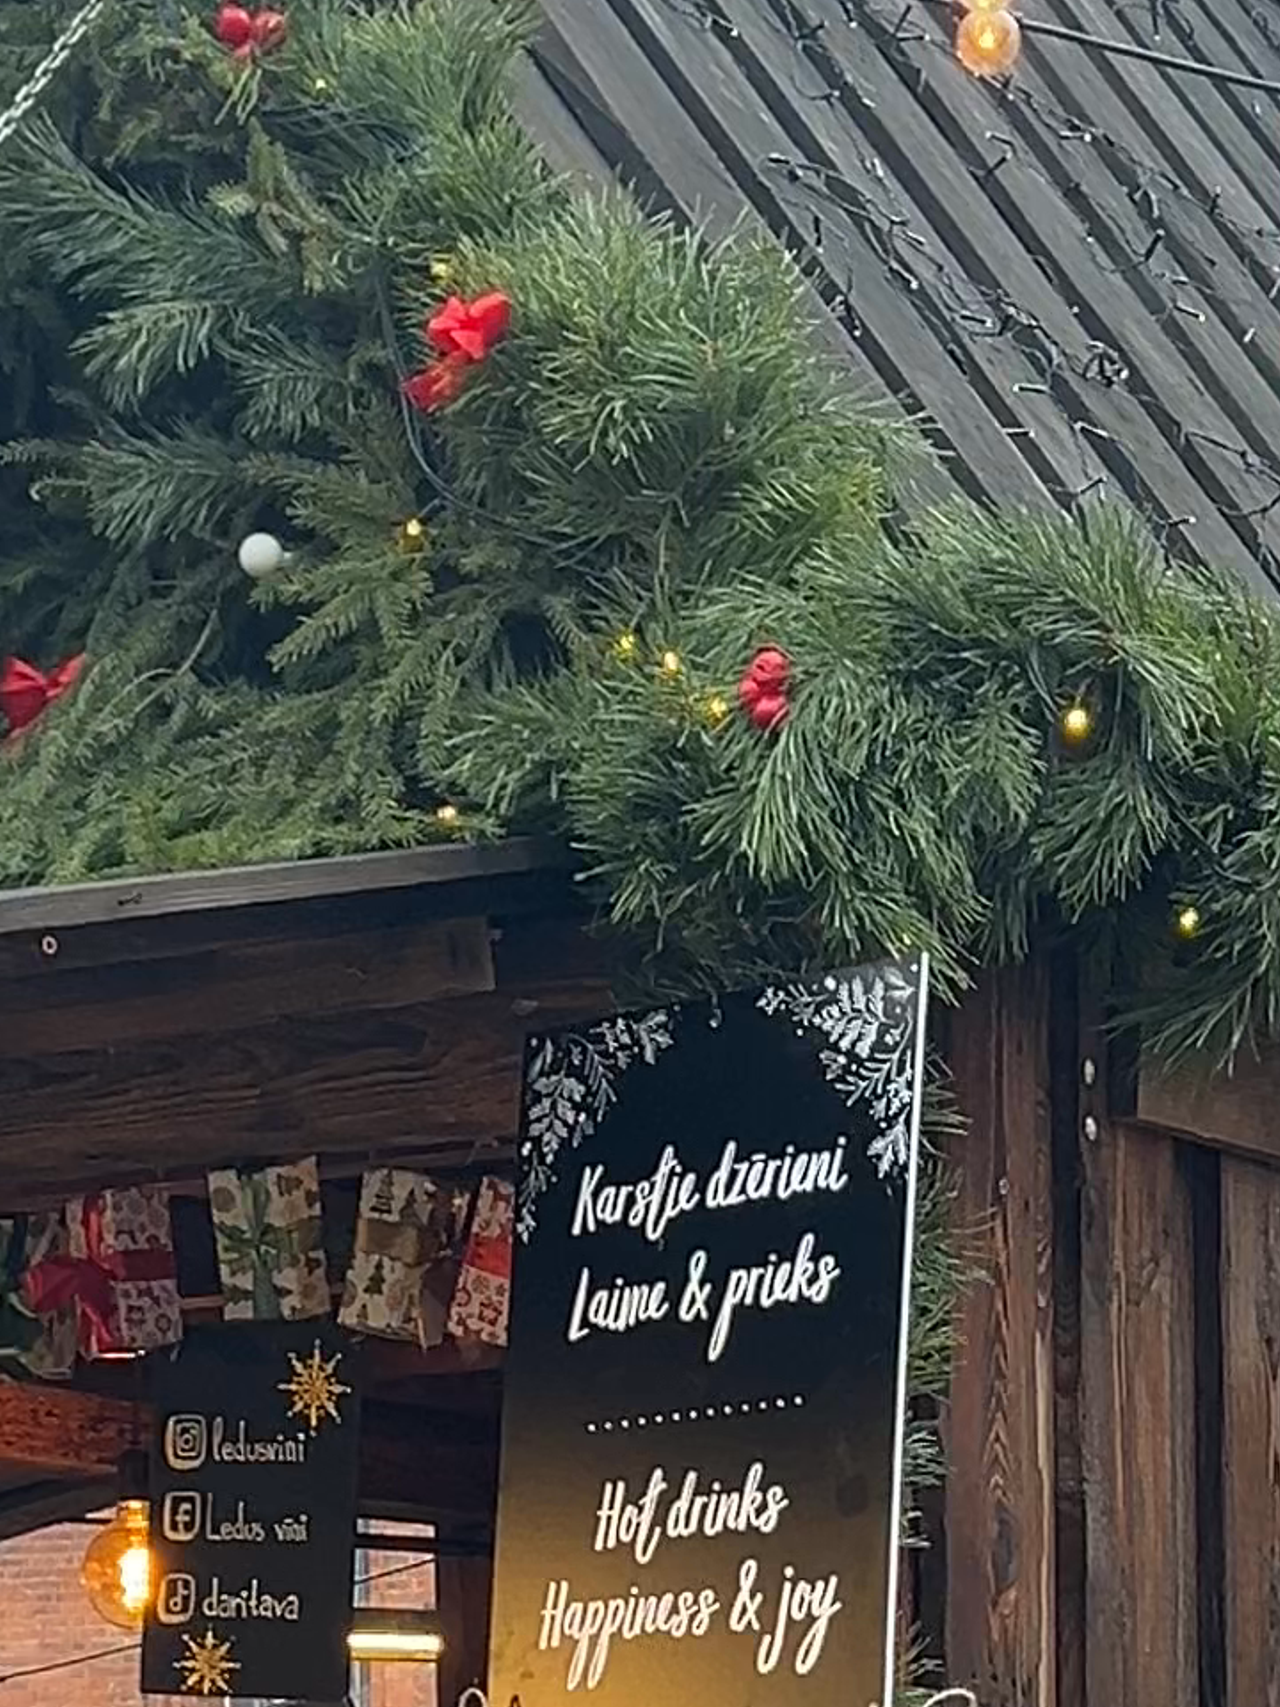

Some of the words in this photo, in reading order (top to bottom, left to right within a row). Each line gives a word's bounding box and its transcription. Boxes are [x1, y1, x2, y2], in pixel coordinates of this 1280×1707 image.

[572, 1144, 701, 1241] Karstie
[705, 1135, 848, 1208] dzērieni
[568, 1267, 669, 1342] Laime
[679, 1250, 712, 1321] &
[708, 1233, 841, 1362] prieks
[206, 1493, 266, 1542] Ledus
[594, 1467, 668, 1564] Hot
[666, 1462, 789, 1538] drinks
[538, 1580, 720, 1691] Happiness
[729, 1559, 763, 1632] &
[756, 1565, 842, 1675] joy
